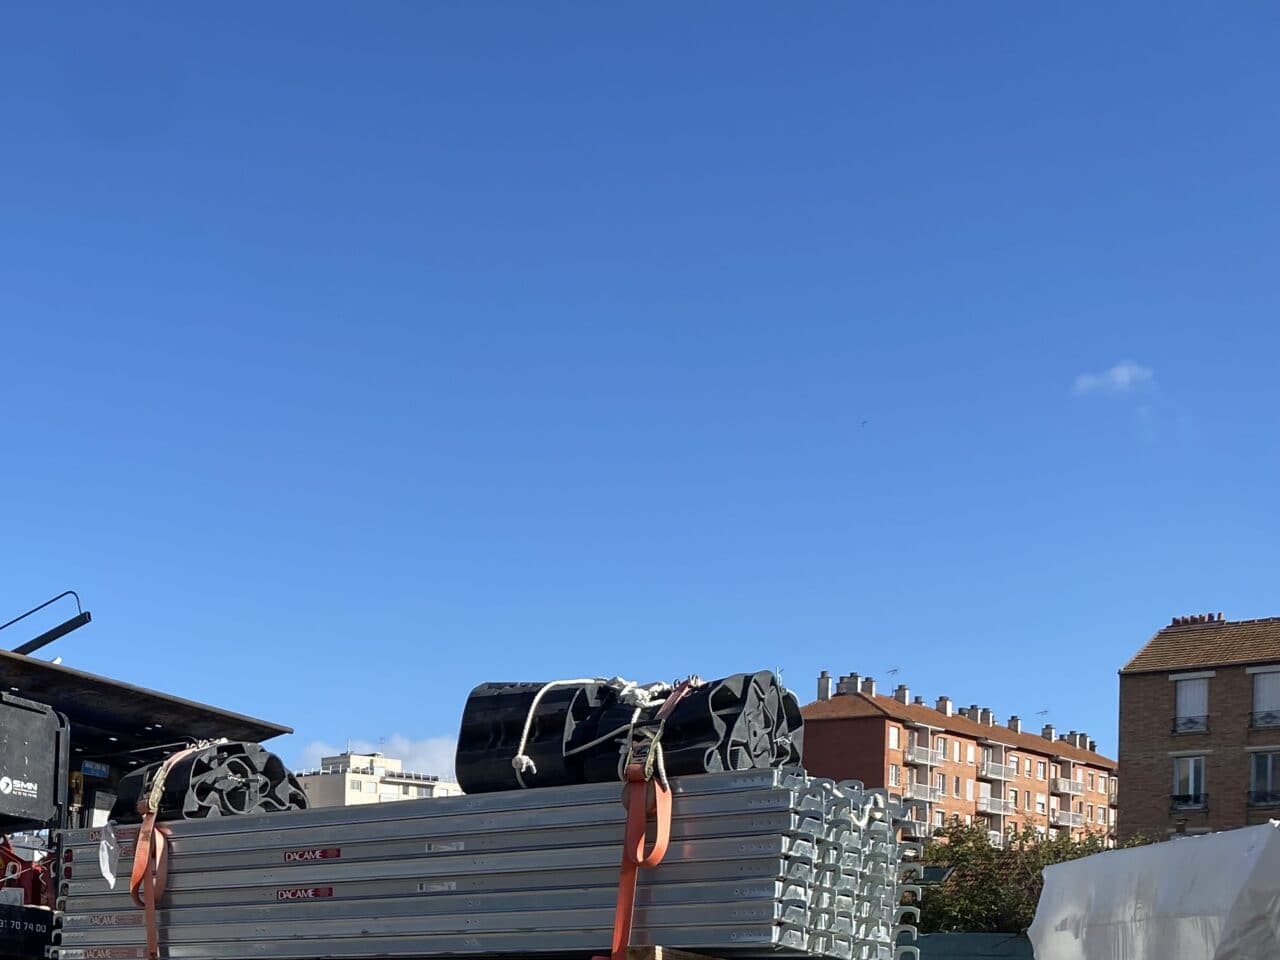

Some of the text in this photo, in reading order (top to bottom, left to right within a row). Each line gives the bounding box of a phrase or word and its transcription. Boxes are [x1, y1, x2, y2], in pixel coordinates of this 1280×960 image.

[12, 779, 38, 791] SMN
[285, 849, 322, 862] DACAME
[278, 888, 315, 900] DACAME
[0, 918, 8, 929] 31
[10, 920, 21, 930] 70
[23, 921, 34, 931] 74
[35, 923, 47, 933] 00
